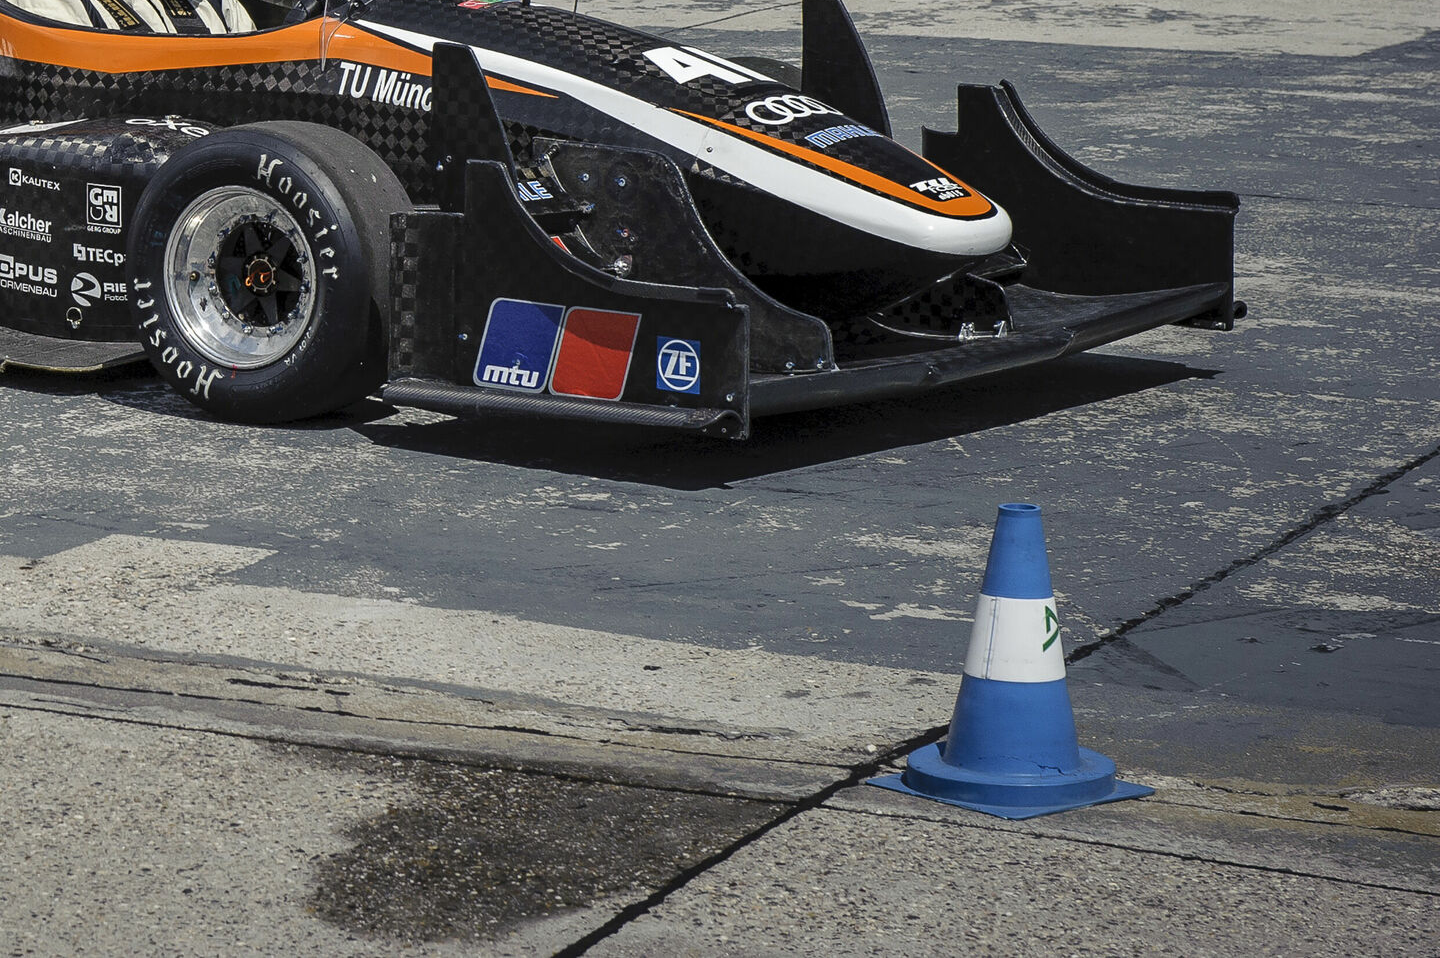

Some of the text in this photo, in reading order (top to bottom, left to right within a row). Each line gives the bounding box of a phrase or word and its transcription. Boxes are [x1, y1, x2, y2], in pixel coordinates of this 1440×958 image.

[338, 62, 372, 98] TU
[22, 174, 61, 191] KAUTEX
[257, 153, 339, 280] Hoosier
[102, 226, 122, 235] GROUP
[86, 247, 127, 267] TECp
[482, 364, 540, 388] mtu
[661, 349, 698, 382] ZF
